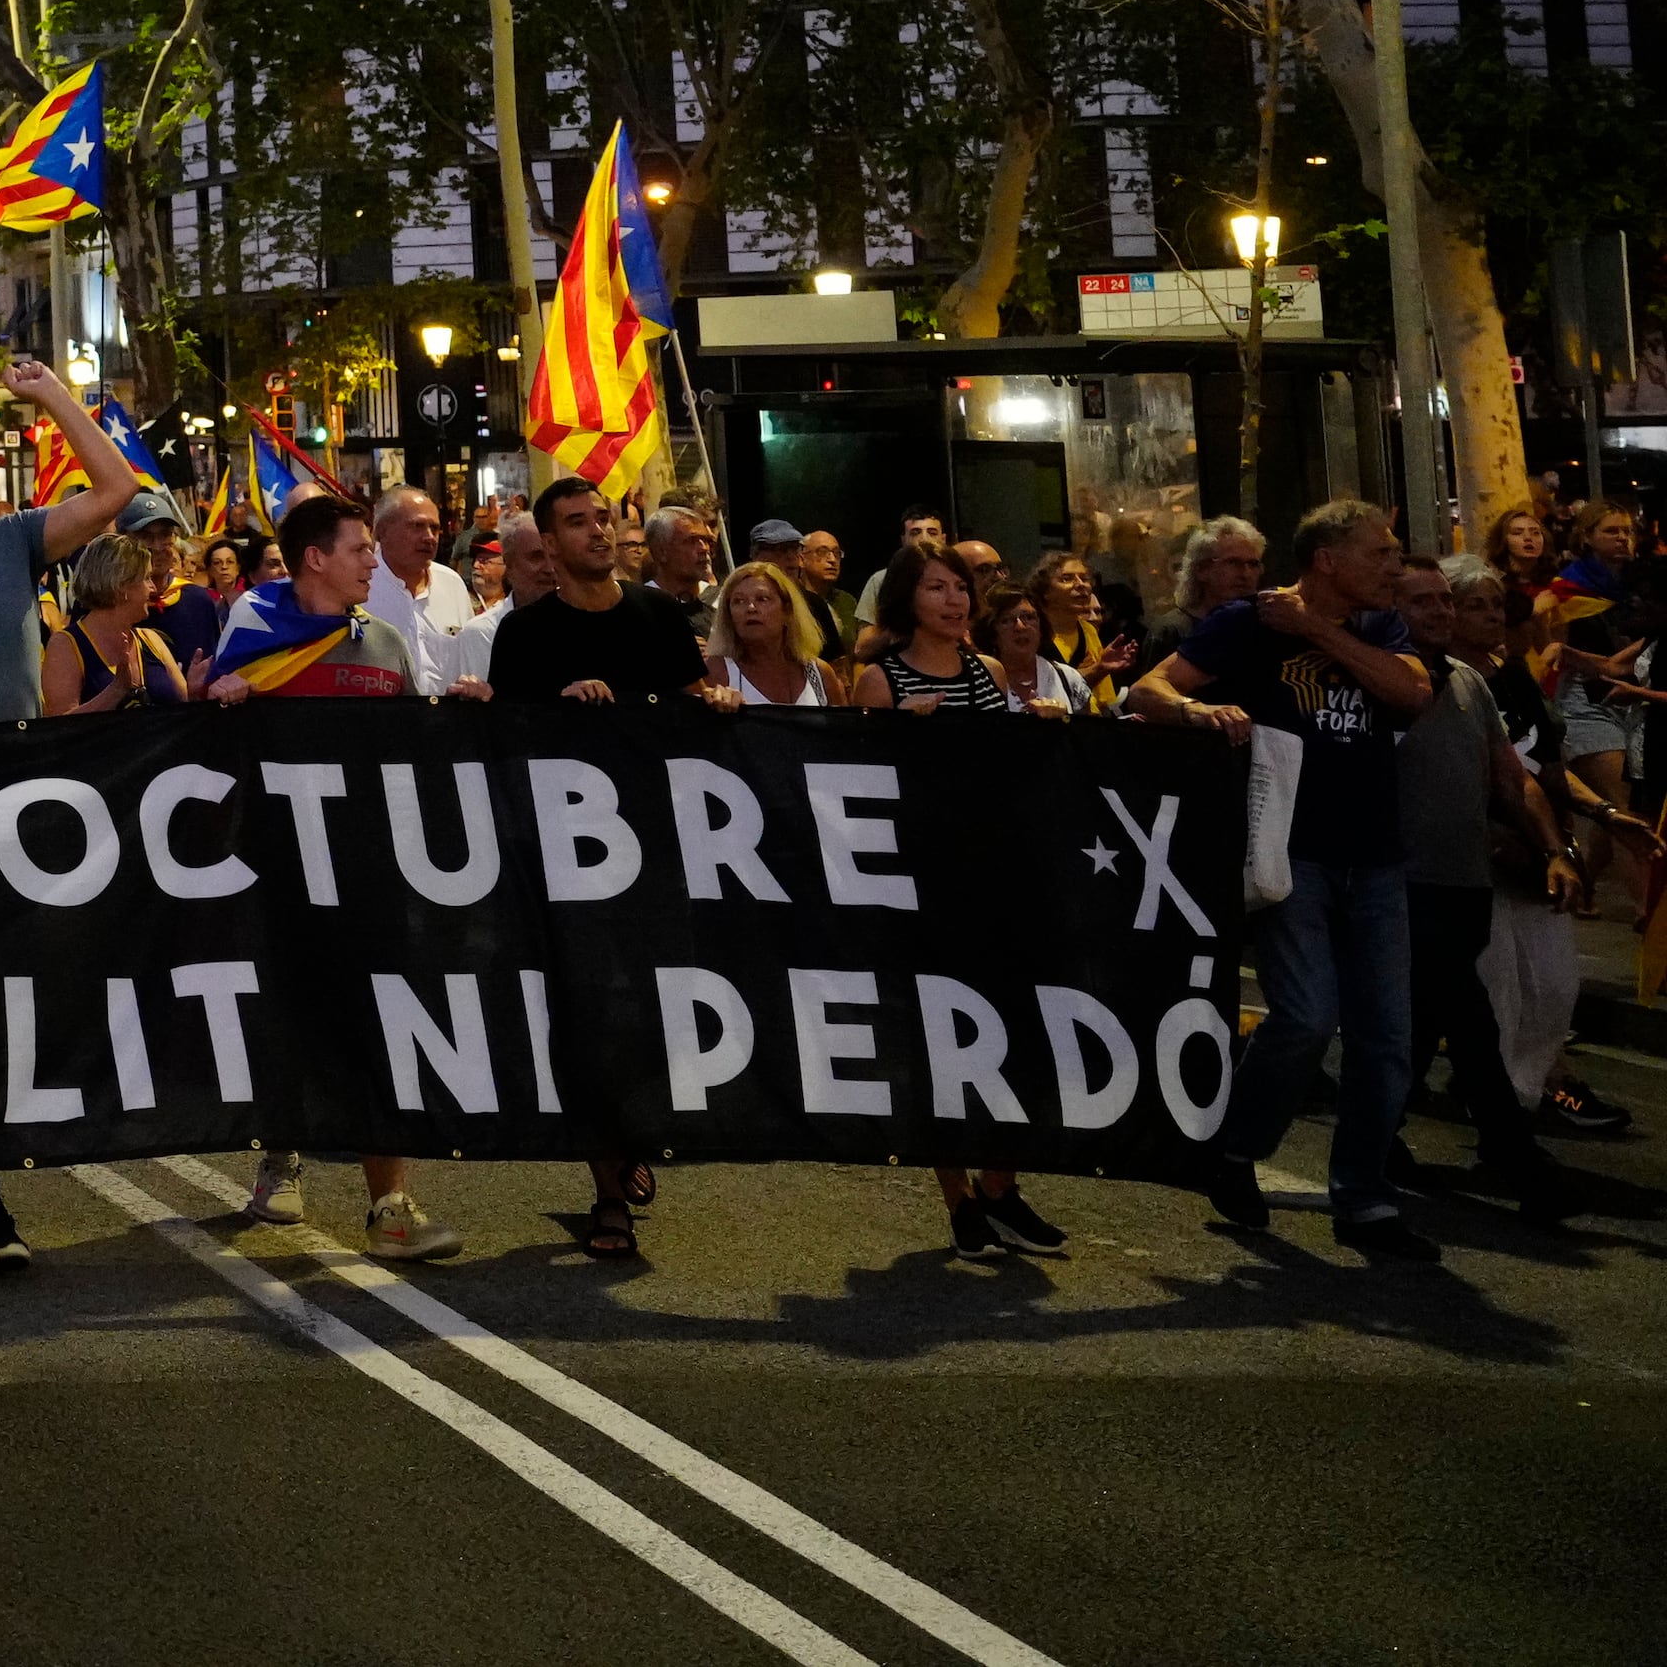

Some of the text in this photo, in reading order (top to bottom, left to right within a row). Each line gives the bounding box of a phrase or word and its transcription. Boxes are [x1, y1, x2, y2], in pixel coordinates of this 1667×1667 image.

[1084, 279, 1100, 292] 22
[1110, 278, 1125, 291] 24
[1327, 686, 1365, 711] VIA
[371, 969, 564, 1115] NI
[654, 955, 1234, 1143] PERDÓ
